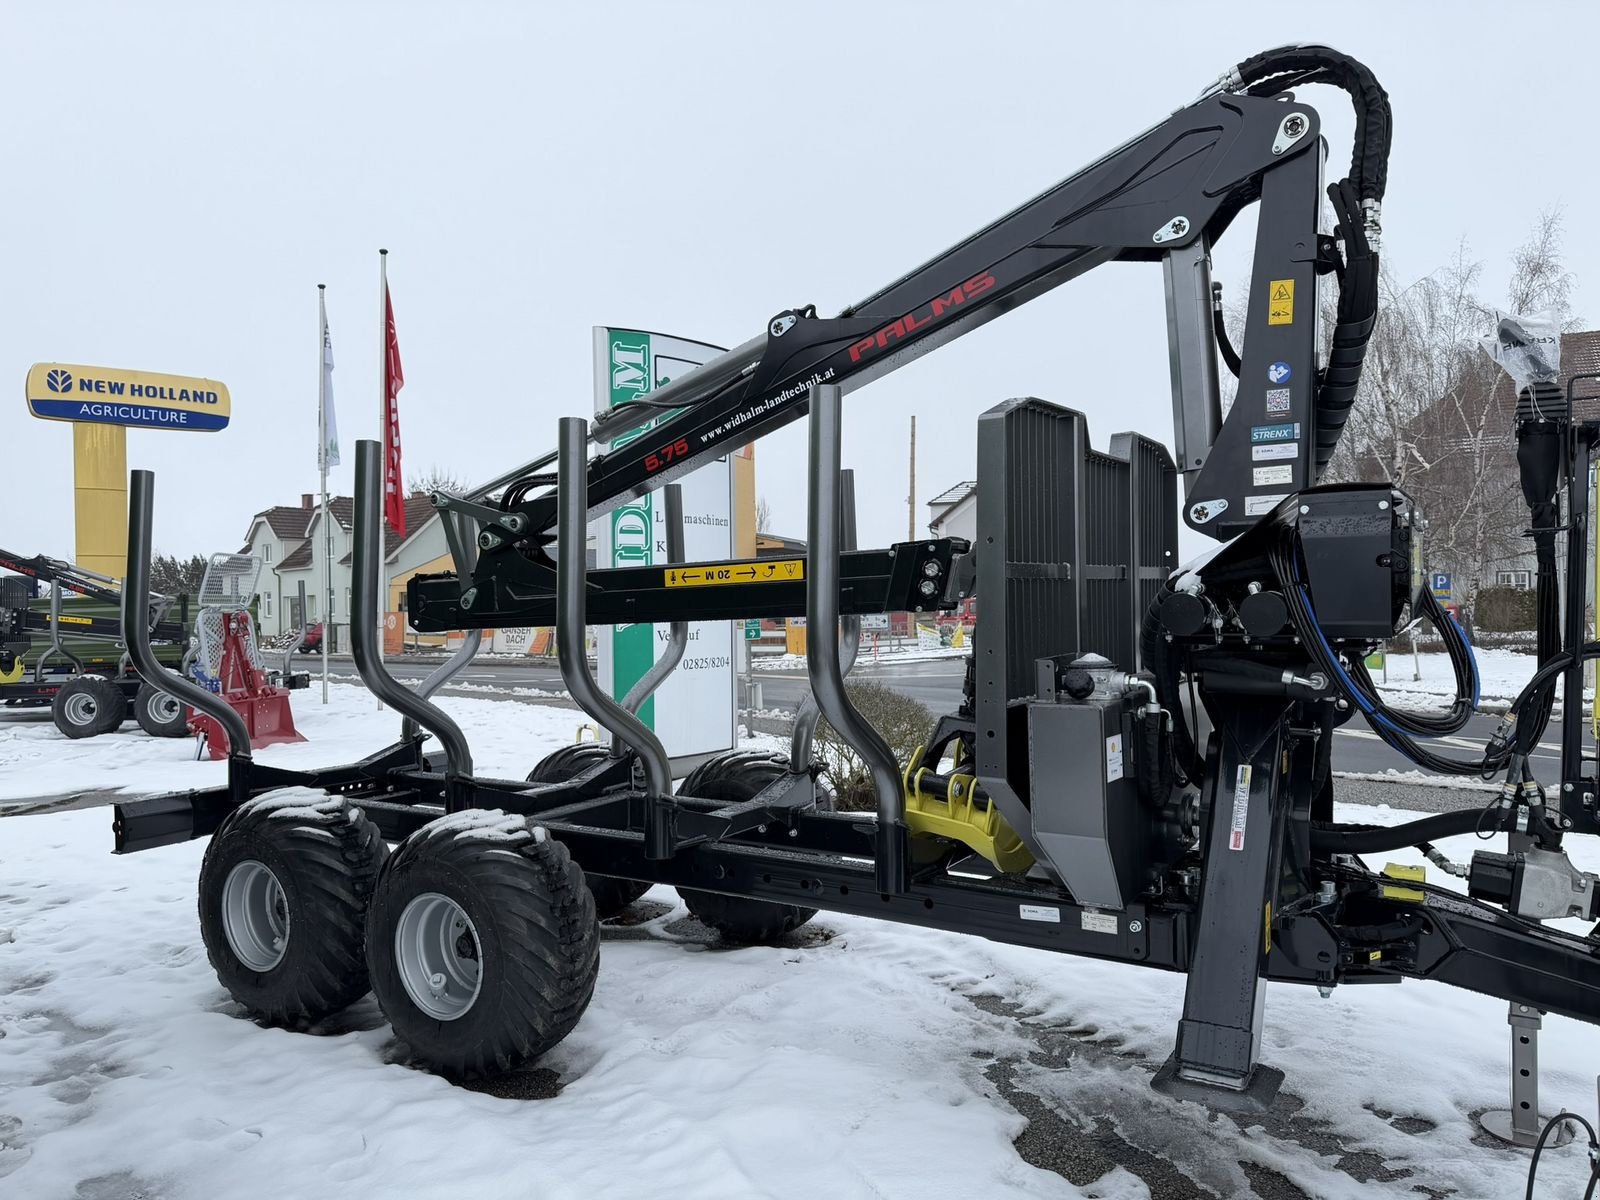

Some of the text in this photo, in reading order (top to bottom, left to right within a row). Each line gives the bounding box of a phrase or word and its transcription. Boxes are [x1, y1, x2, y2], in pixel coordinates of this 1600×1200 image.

[848, 270, 996, 362] PALMS
[79, 378, 218, 404] NEW HOLLAND
[700, 366, 836, 444] www.widhalm-landtechnik.at
[79, 403, 188, 424] AGRICULTURE
[1252, 429, 1289, 440] STRENX
[644, 438, 689, 472] 5.75
[655, 511, 729, 527] Lmaschinen
[705, 569, 731, 580] 20 M
[1437, 575, 1447, 588] P
[505, 634, 526, 644] DACH
[657, 628, 701, 641] Veuf
[683, 657, 730, 670] 02825/8204
